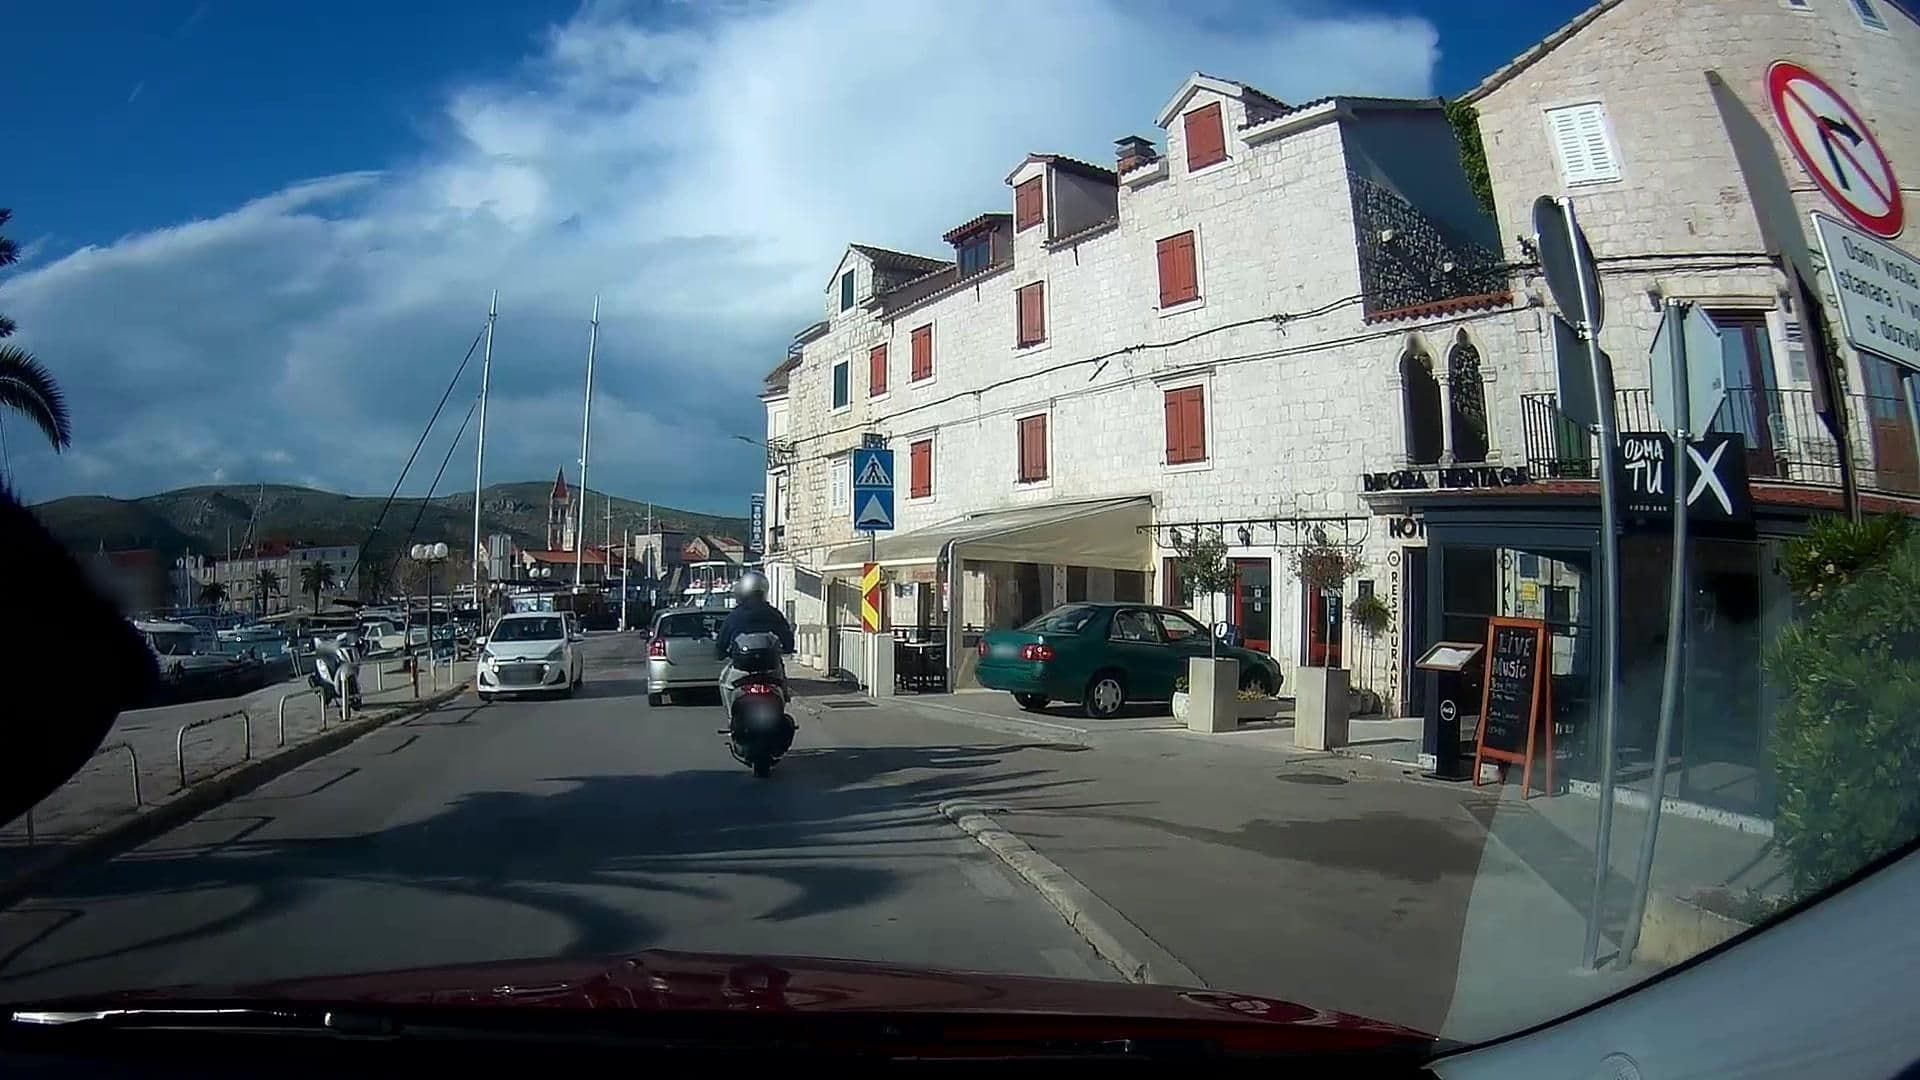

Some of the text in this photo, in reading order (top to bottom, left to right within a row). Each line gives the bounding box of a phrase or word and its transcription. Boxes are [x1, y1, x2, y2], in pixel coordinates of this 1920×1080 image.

[1841, 235, 1880, 272] Osim
[1839, 268, 1893, 308] stanara
[1895, 290, 1905, 314] i
[1865, 314, 1876, 334] s
[1624, 438, 1665, 461] ODMA
[1624, 459, 1665, 494] TU
[1390, 571, 1399, 698] RESTAURANT
